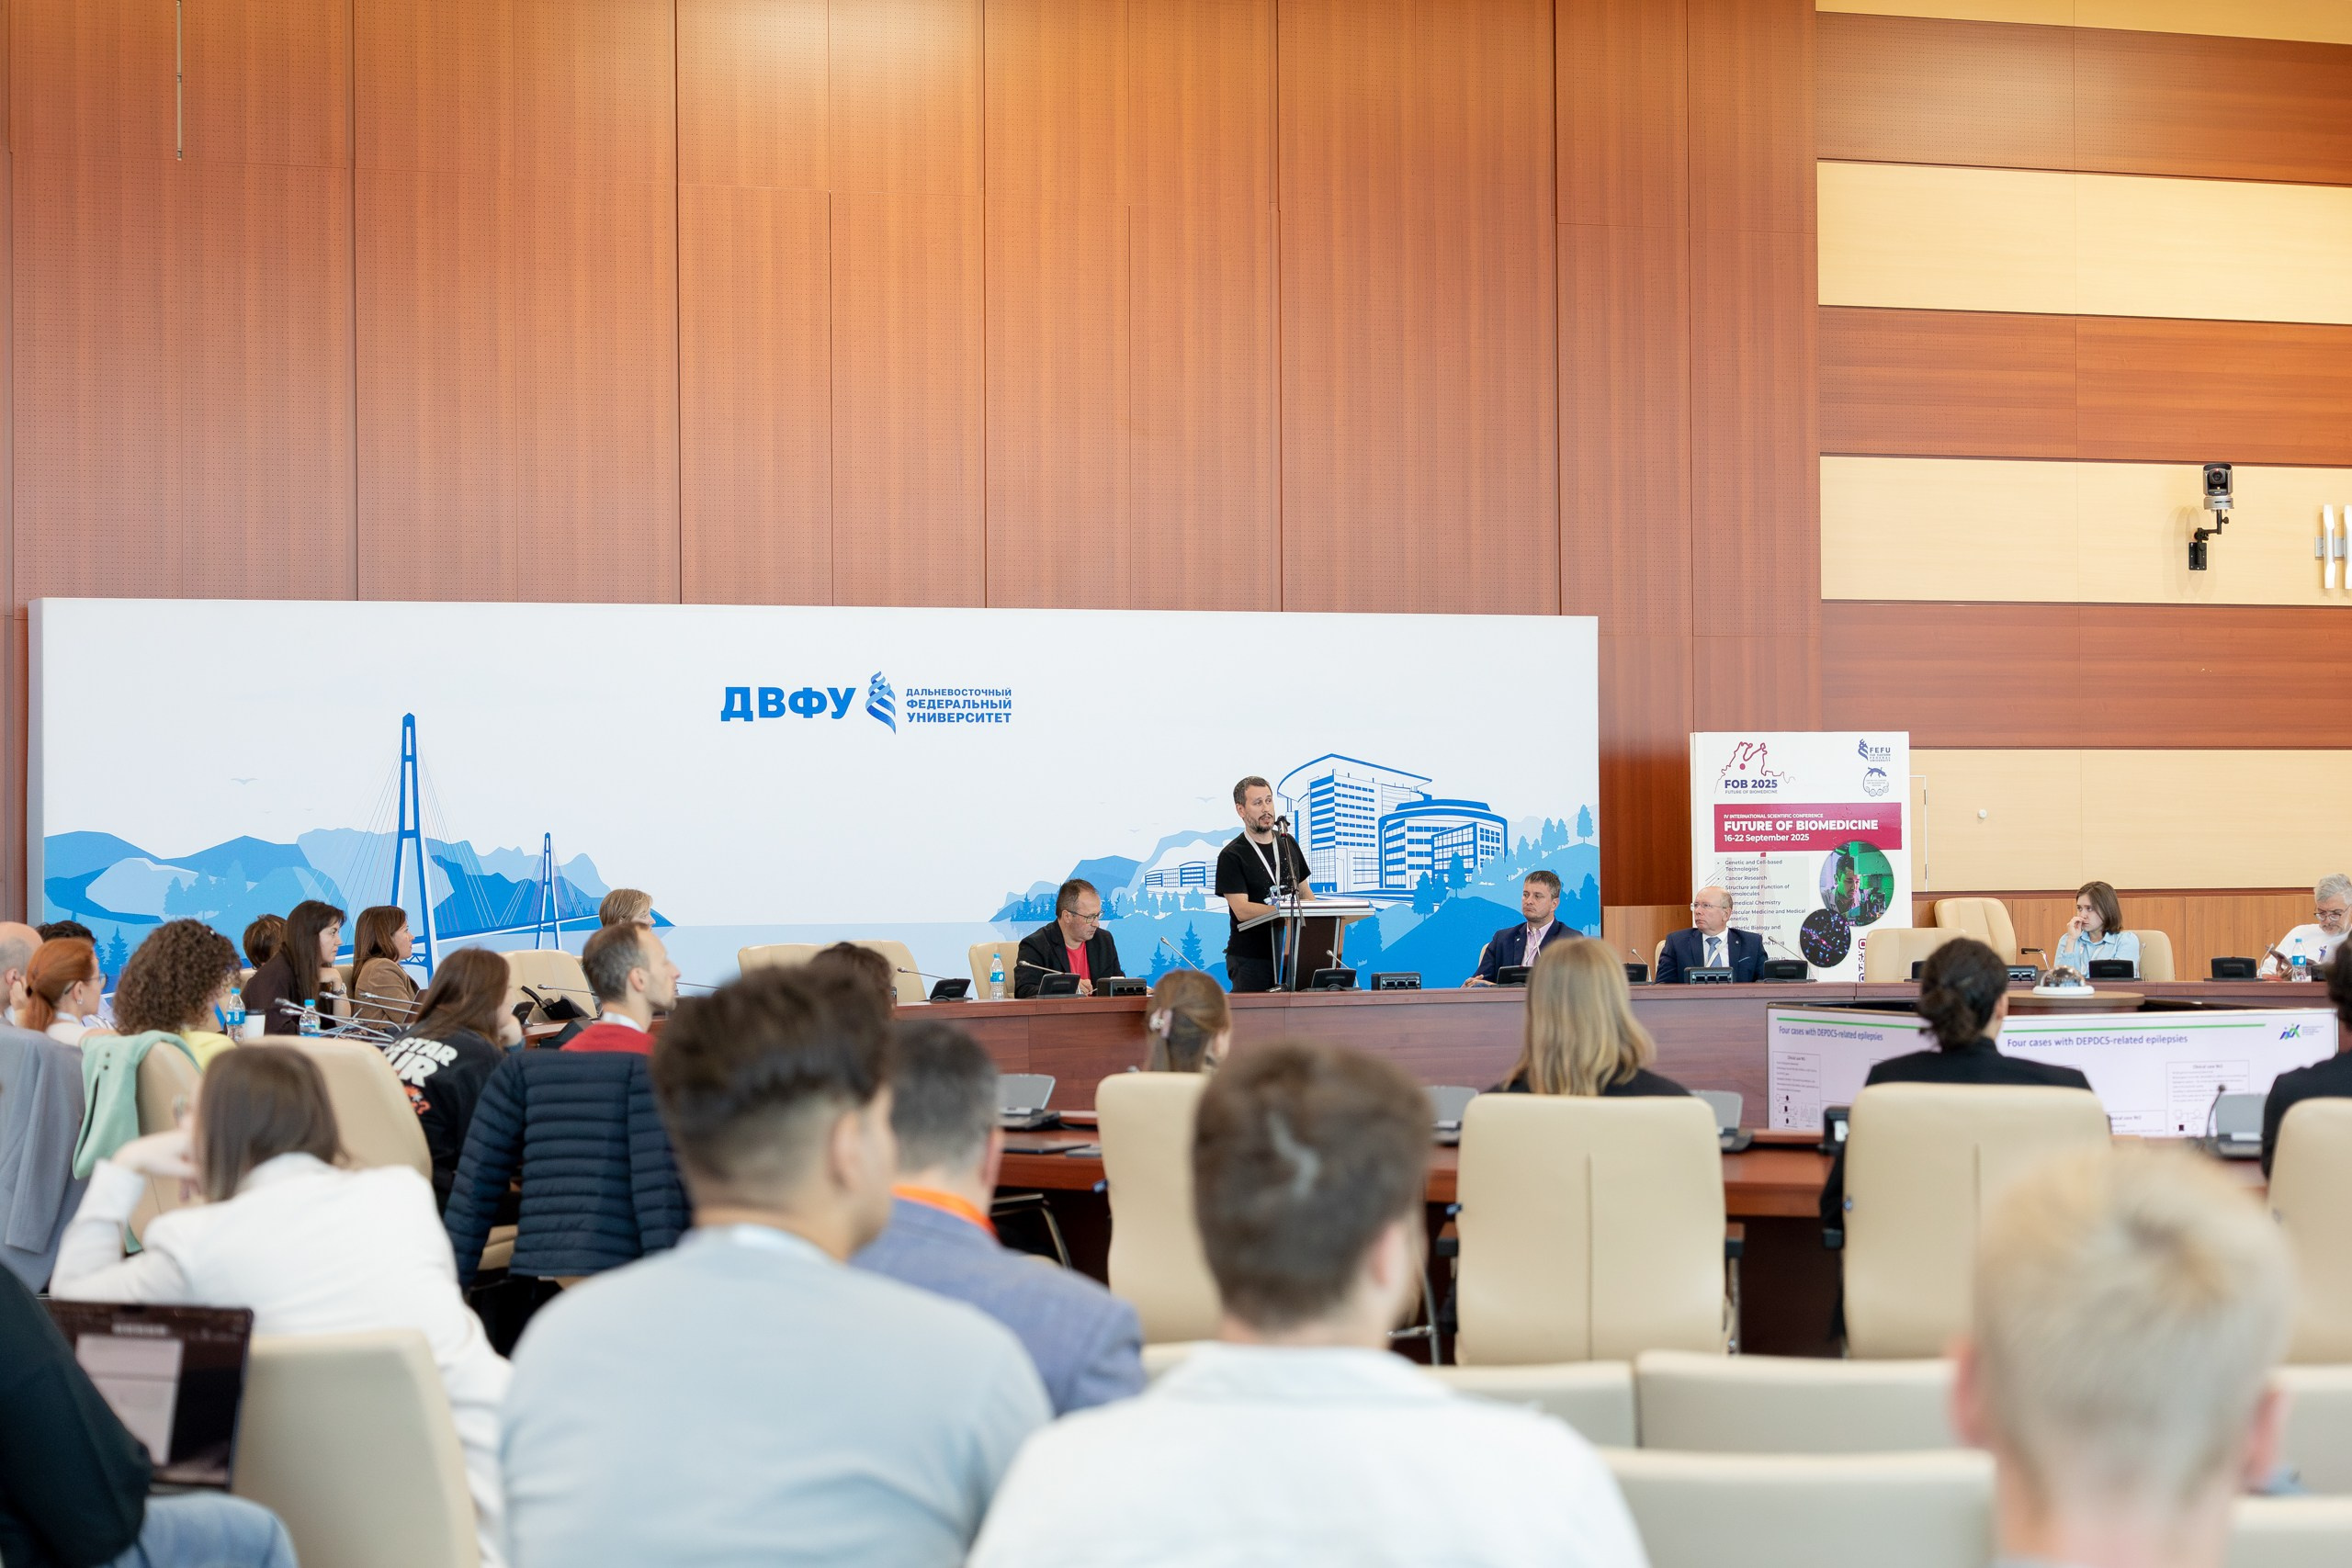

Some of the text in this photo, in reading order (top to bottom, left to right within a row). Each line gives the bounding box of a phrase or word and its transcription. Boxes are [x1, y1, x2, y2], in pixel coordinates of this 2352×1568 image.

[906, 688, 1012, 697] ДАЛЬНЕВОСТОЧНЫЙ
[720, 686, 856, 722] ДВФУ
[906, 698, 1012, 710] ФЕДЕРАЛЬНЫЙ
[907, 712, 1012, 723] УНИВЕРСИТЕТ
[1724, 779, 1778, 789] FOB 2025
[1724, 819, 1879, 831] FUTURE OF BIOMEDICINE
[1724, 833, 1810, 843] 16-22 September 2025
[1779, 1026, 1791, 1034] Four
[1805, 1028, 1816, 1036] with
[1858, 1032, 1883, 1042] epilepsies
[2007, 1038, 2026, 1047] Four
[2029, 1039, 2052, 1047] cases
[2054, 1036, 2074, 1046] with
[2145, 1034, 2188, 1045] epilepsies
